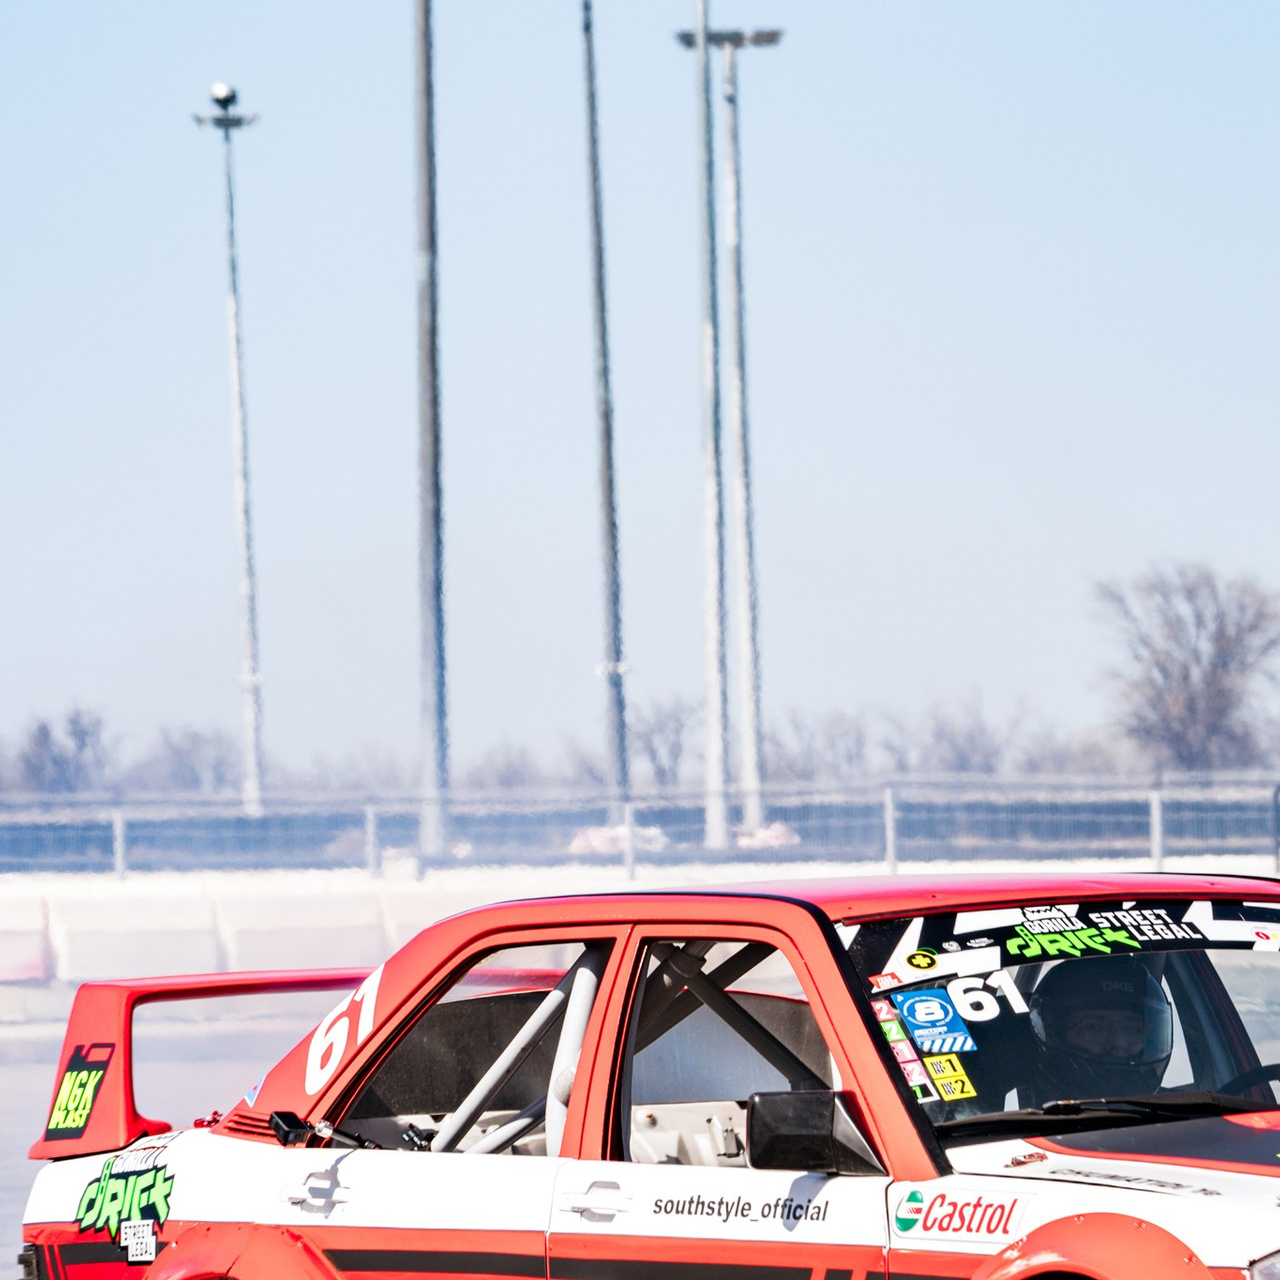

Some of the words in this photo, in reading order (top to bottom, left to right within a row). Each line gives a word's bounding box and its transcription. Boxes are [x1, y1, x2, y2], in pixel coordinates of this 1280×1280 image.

[1023, 916, 1088, 935] GORILLA
[1088, 909, 1174, 928] STREET
[1127, 923, 1203, 941] LEGAL
[947, 969, 1030, 1022] 61
[875, 1002, 892, 1020] 2
[305, 962, 386, 1096] 61
[885, 1022, 901, 1039] 2
[898, 1043, 912, 1060] 1
[907, 1063, 924, 1082] 2
[944, 1058, 958, 1073] 1
[56, 1070, 104, 1112] NGK
[954, 1079, 970, 1095] 2
[653, 1195, 829, 1223] southstyle_official
[922, 1193, 1019, 1235] Castrol
